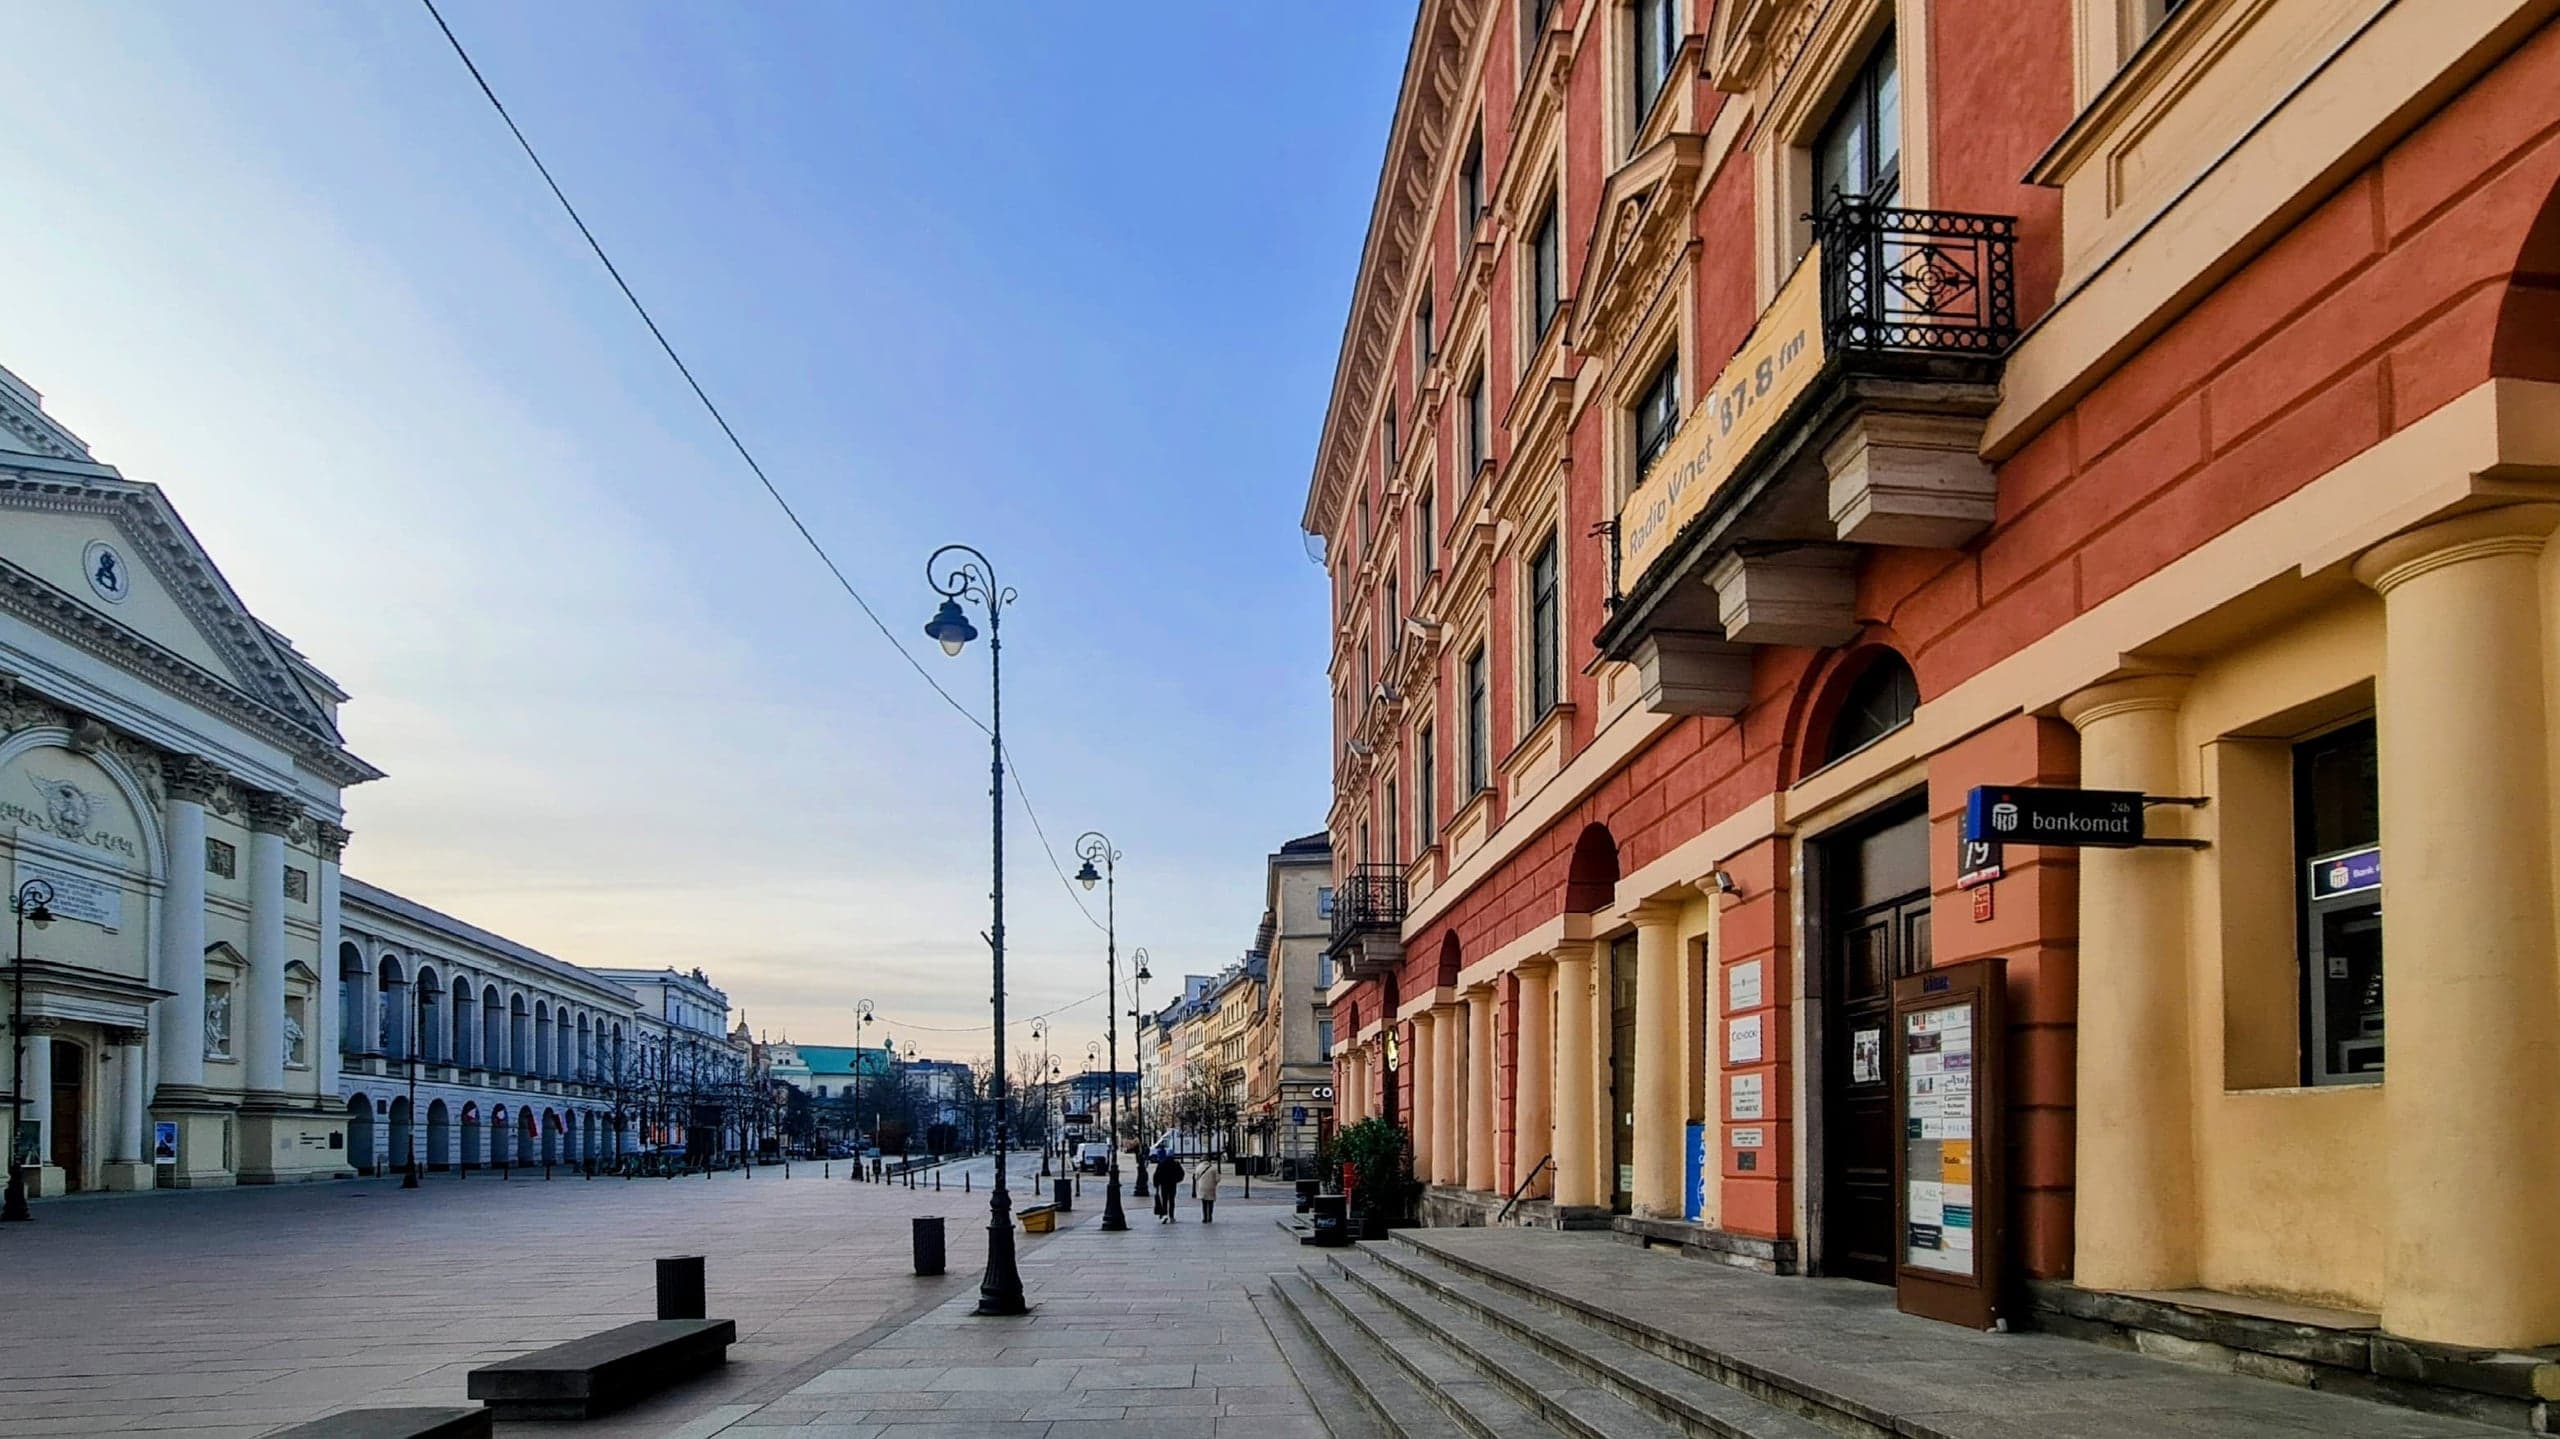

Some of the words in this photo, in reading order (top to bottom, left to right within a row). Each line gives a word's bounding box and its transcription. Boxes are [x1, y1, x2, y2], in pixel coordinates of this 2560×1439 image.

[1630, 499, 1666, 560] Radio
[1668, 434, 1713, 505] Wnet
[1720, 354, 1774, 438] 87.8
[1779, 329, 1805, 372] fm
[2111, 802, 2131, 813] 24h
[2032, 811, 2130, 833] bankomat
